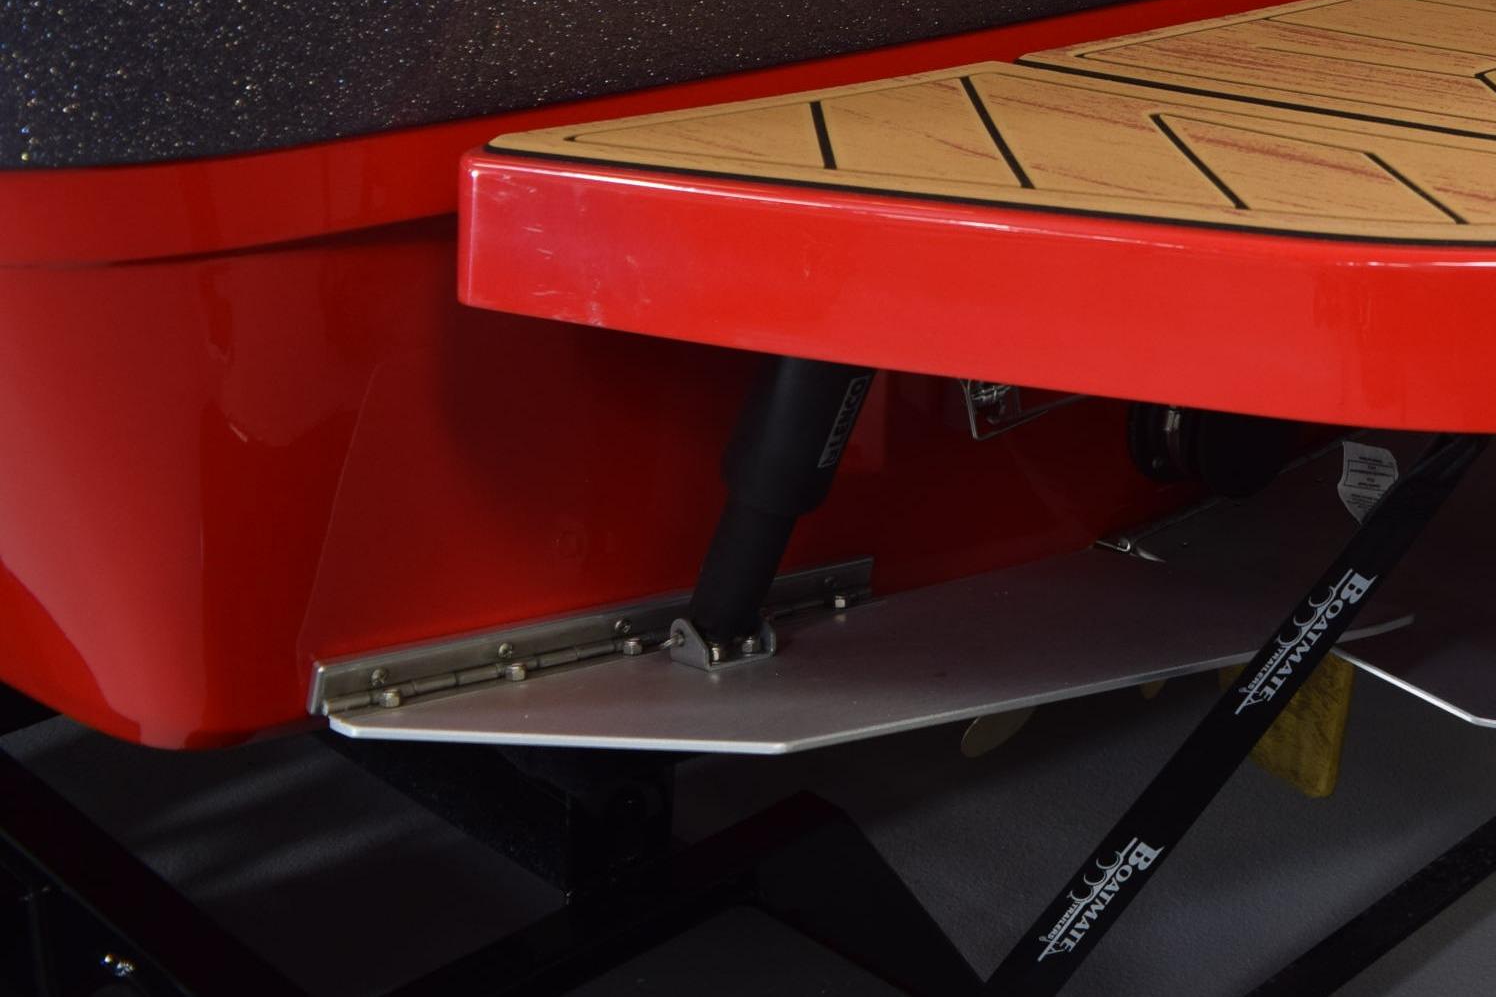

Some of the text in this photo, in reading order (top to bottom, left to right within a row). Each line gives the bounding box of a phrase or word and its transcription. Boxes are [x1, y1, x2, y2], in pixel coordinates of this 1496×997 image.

[1247, 644, 1287, 690] TRAILERS
[1259, 572, 1378, 702] BOATMATE
[1047, 901, 1081, 940] TRAILERS
[1059, 841, 1165, 952] BOATMATE
